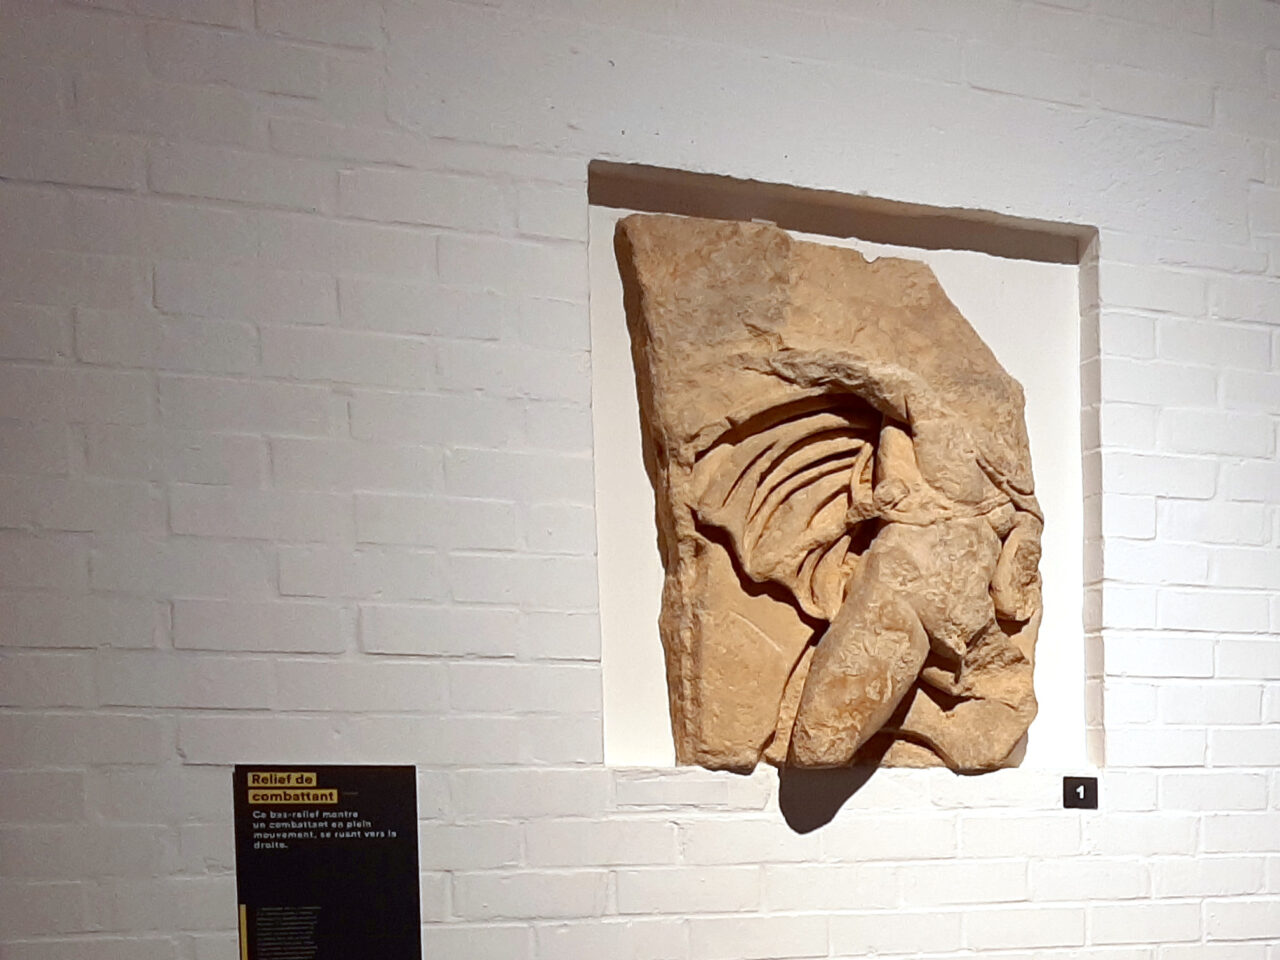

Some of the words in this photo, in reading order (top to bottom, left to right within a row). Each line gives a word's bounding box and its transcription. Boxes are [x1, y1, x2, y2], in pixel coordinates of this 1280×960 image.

[252, 773, 292, 785] Relief
[295, 774, 313, 785] de
[252, 791, 334, 801] combattant
[1076, 785, 1084, 799] 1
[252, 810, 267, 819] Ce
